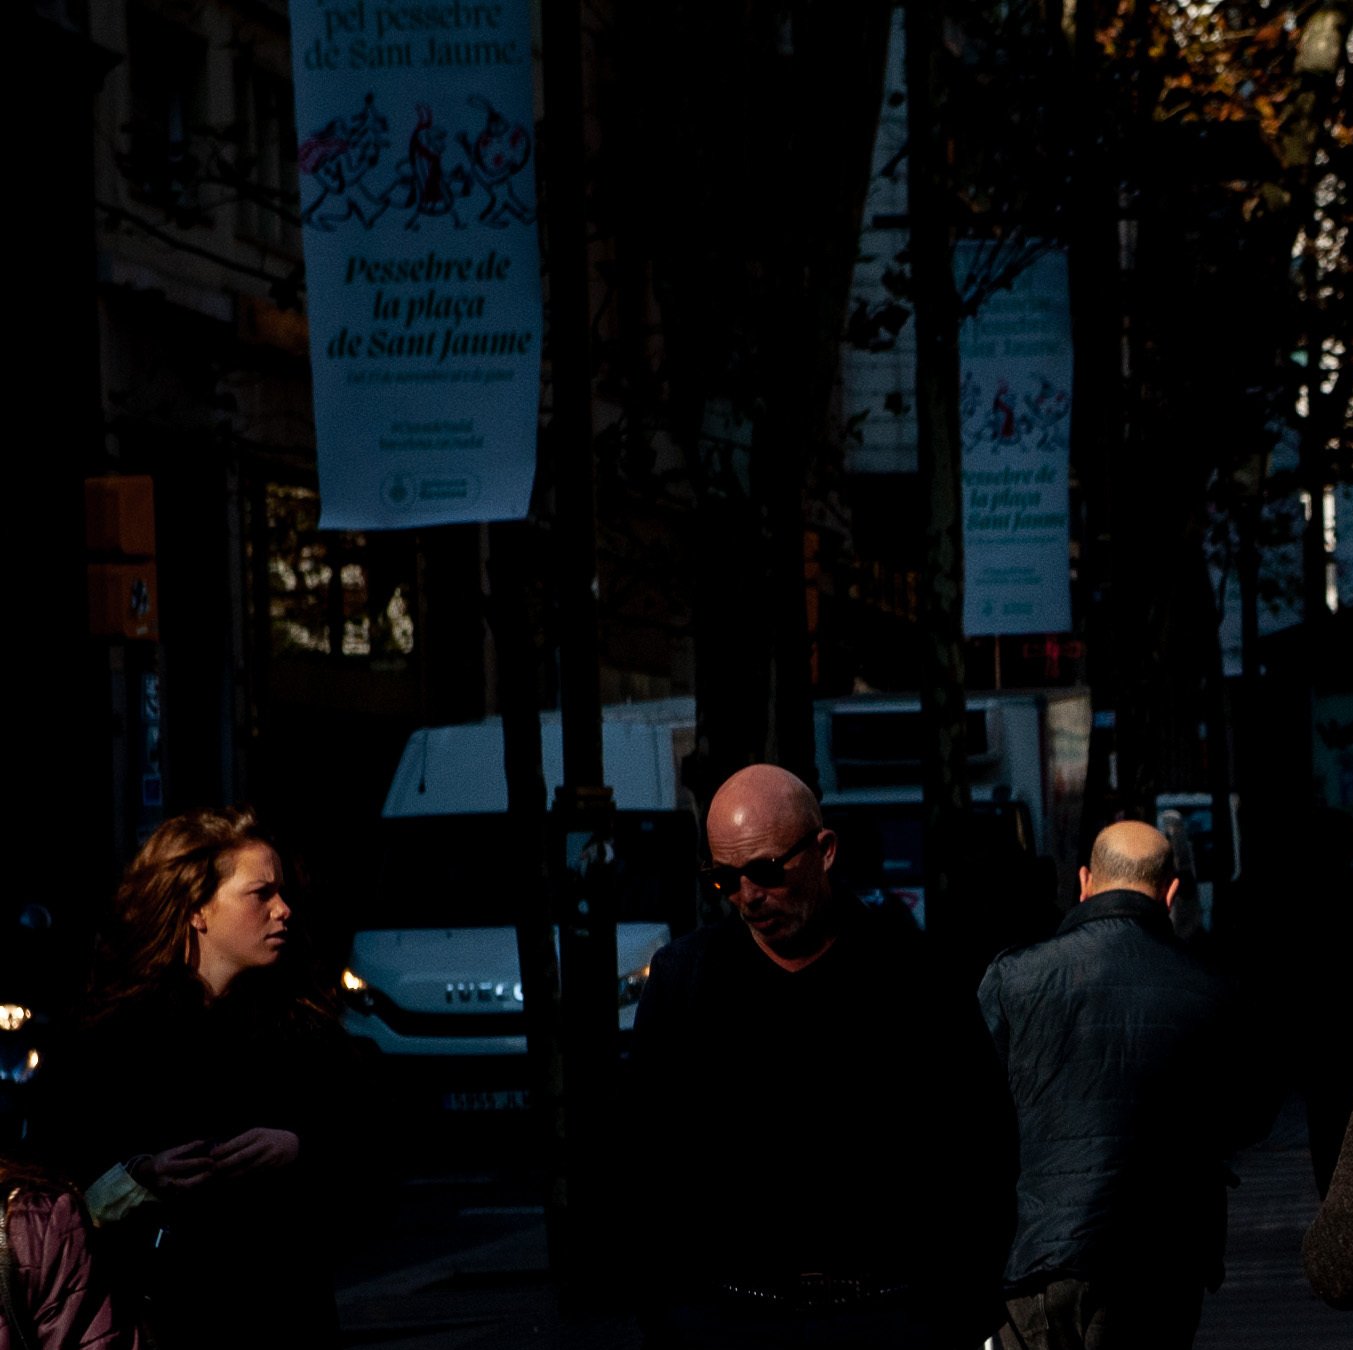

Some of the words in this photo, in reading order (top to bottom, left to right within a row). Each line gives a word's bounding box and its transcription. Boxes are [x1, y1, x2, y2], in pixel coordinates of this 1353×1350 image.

[304, 39, 340, 70] de
[346, 251, 472, 284] Pessebre
[475, 250, 511, 281] de
[374, 288, 400, 320] la
[403, 288, 485, 328] plaça
[327, 327, 362, 359] de
[367, 330, 436, 358] Sant
[437, 329, 533, 364] Jaume
